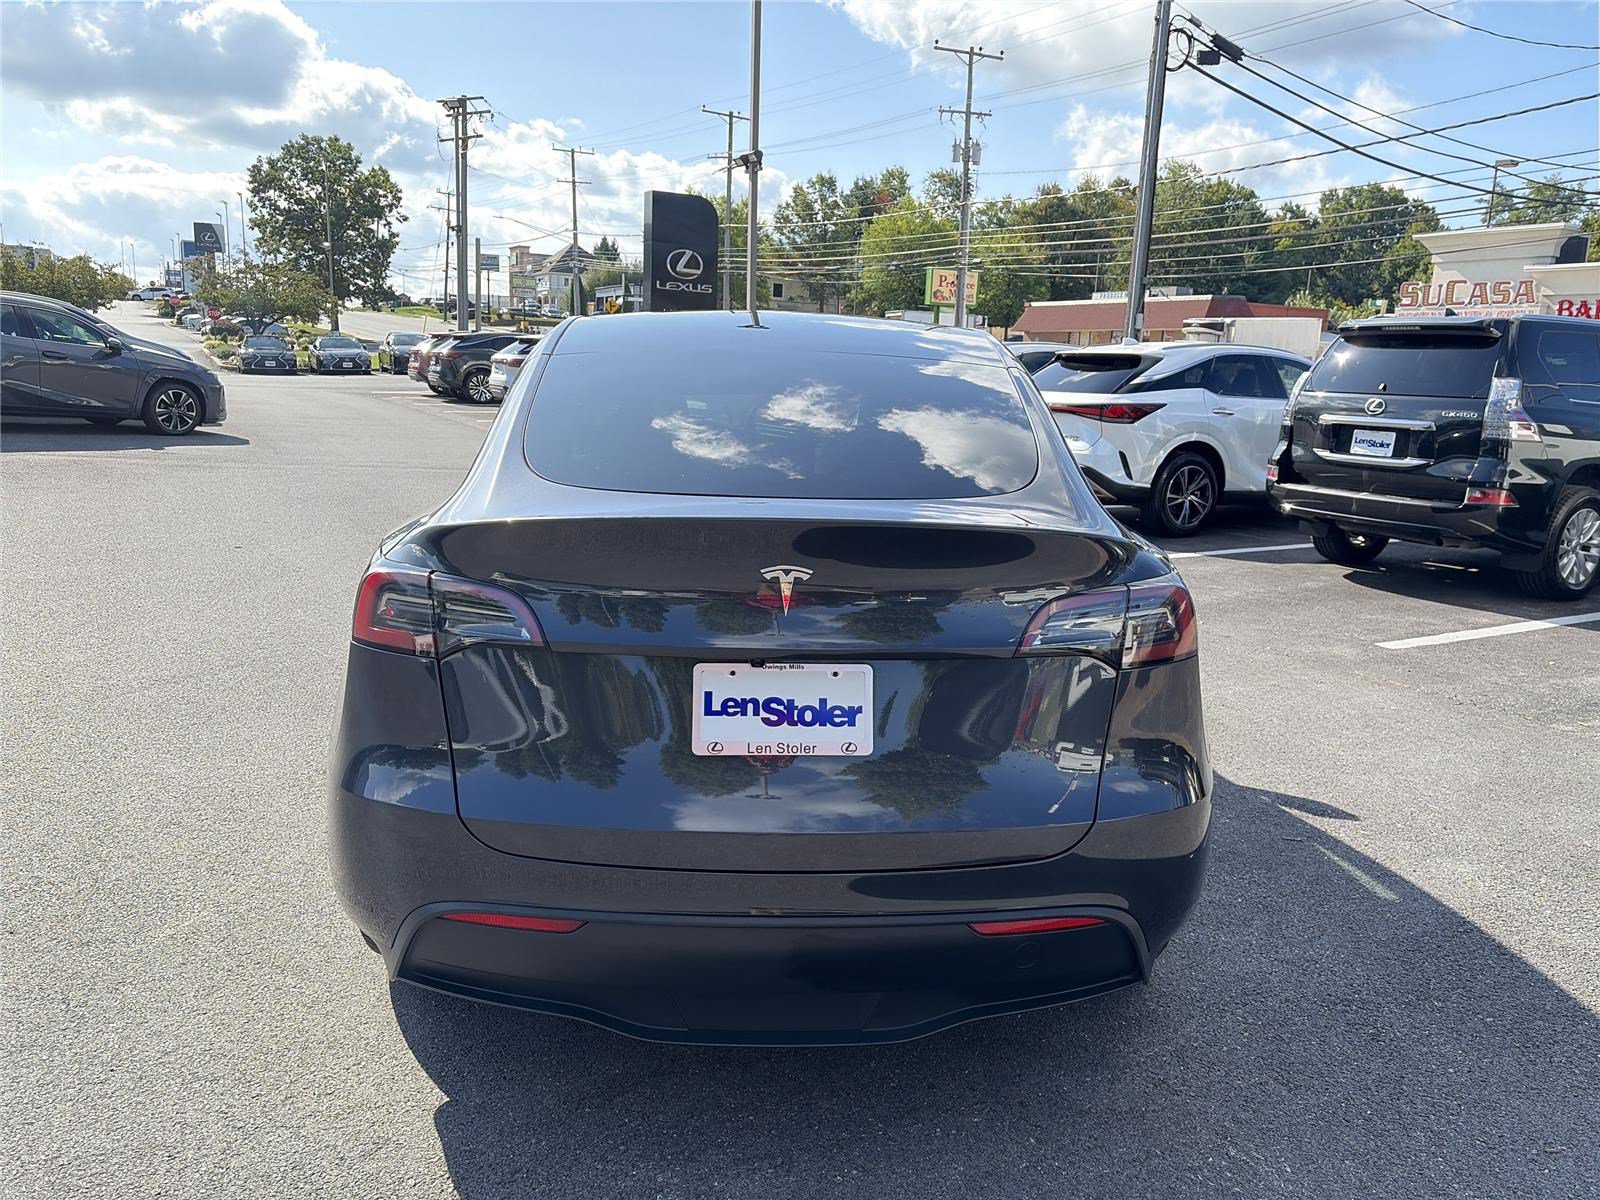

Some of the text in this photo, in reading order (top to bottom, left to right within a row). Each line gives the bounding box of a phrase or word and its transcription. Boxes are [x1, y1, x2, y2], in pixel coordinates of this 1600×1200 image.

[656, 280, 713, 293] LEXUS
[938, 275, 975, 289] Proce
[1556, 299, 1600, 319] BA
[747, 742, 817, 754] Len Stoler
